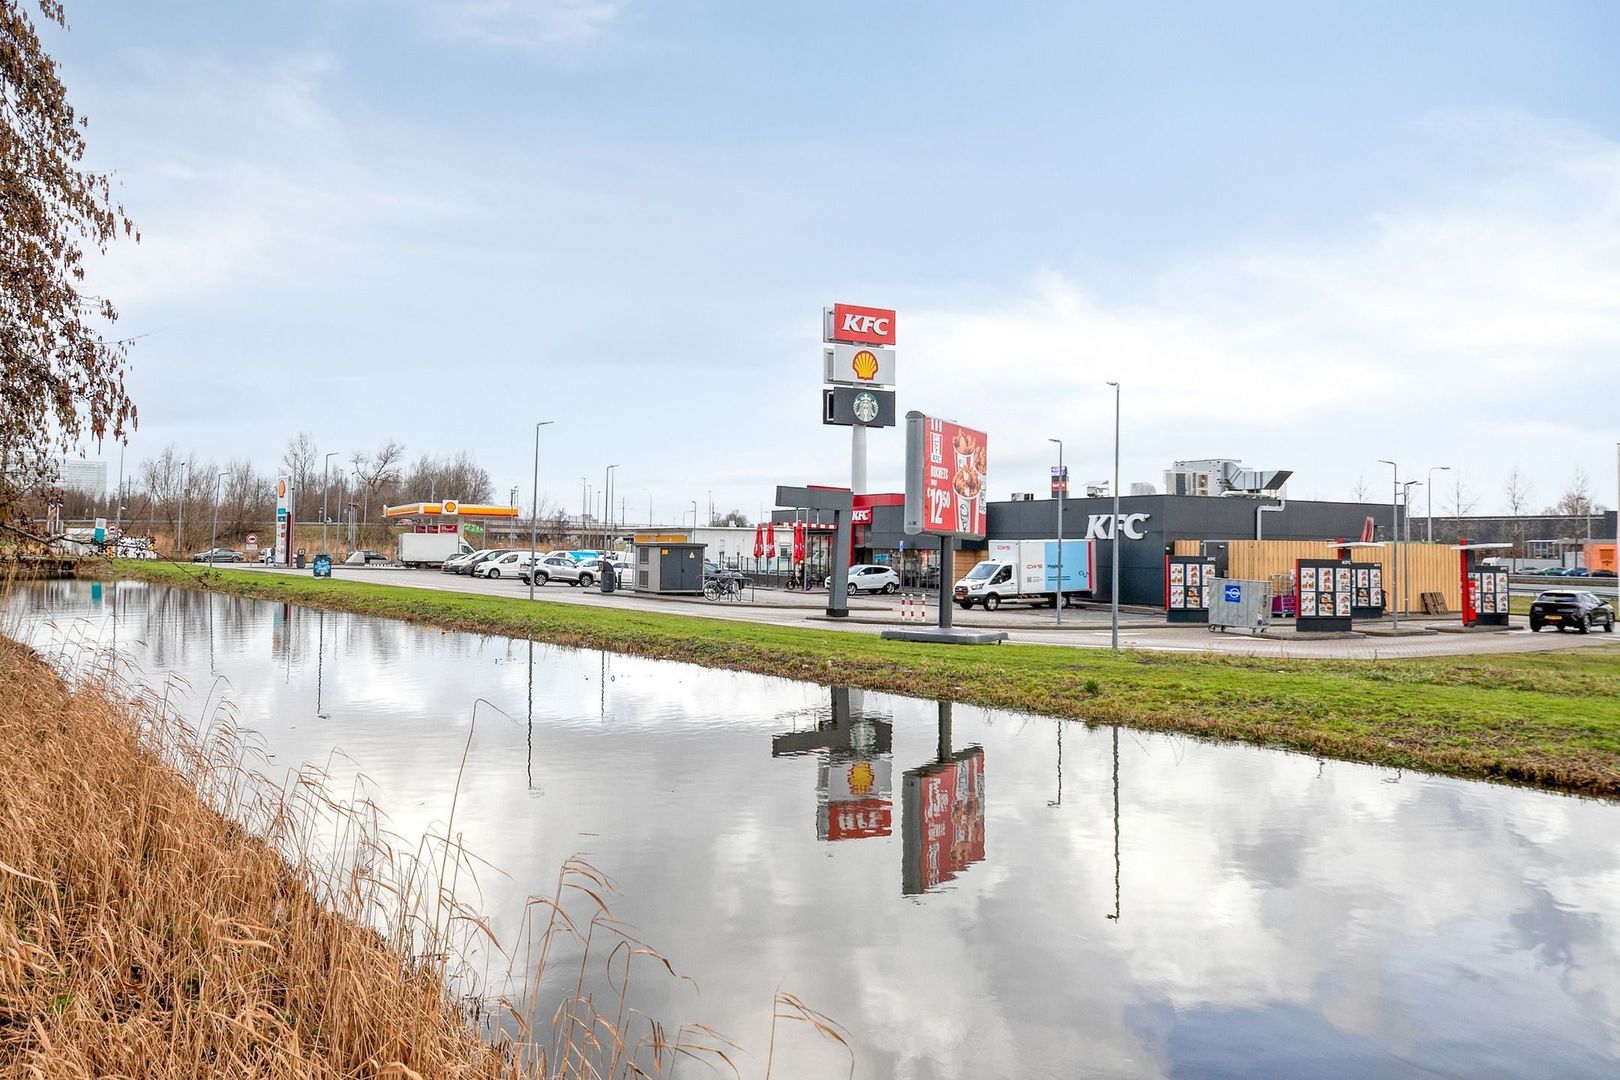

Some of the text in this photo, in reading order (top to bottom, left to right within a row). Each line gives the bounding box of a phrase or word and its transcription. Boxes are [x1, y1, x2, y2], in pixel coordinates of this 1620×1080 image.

[841, 313, 889, 336] KFC
[852, 509, 870, 521] KFC
[1084, 513, 1151, 540] KFC
